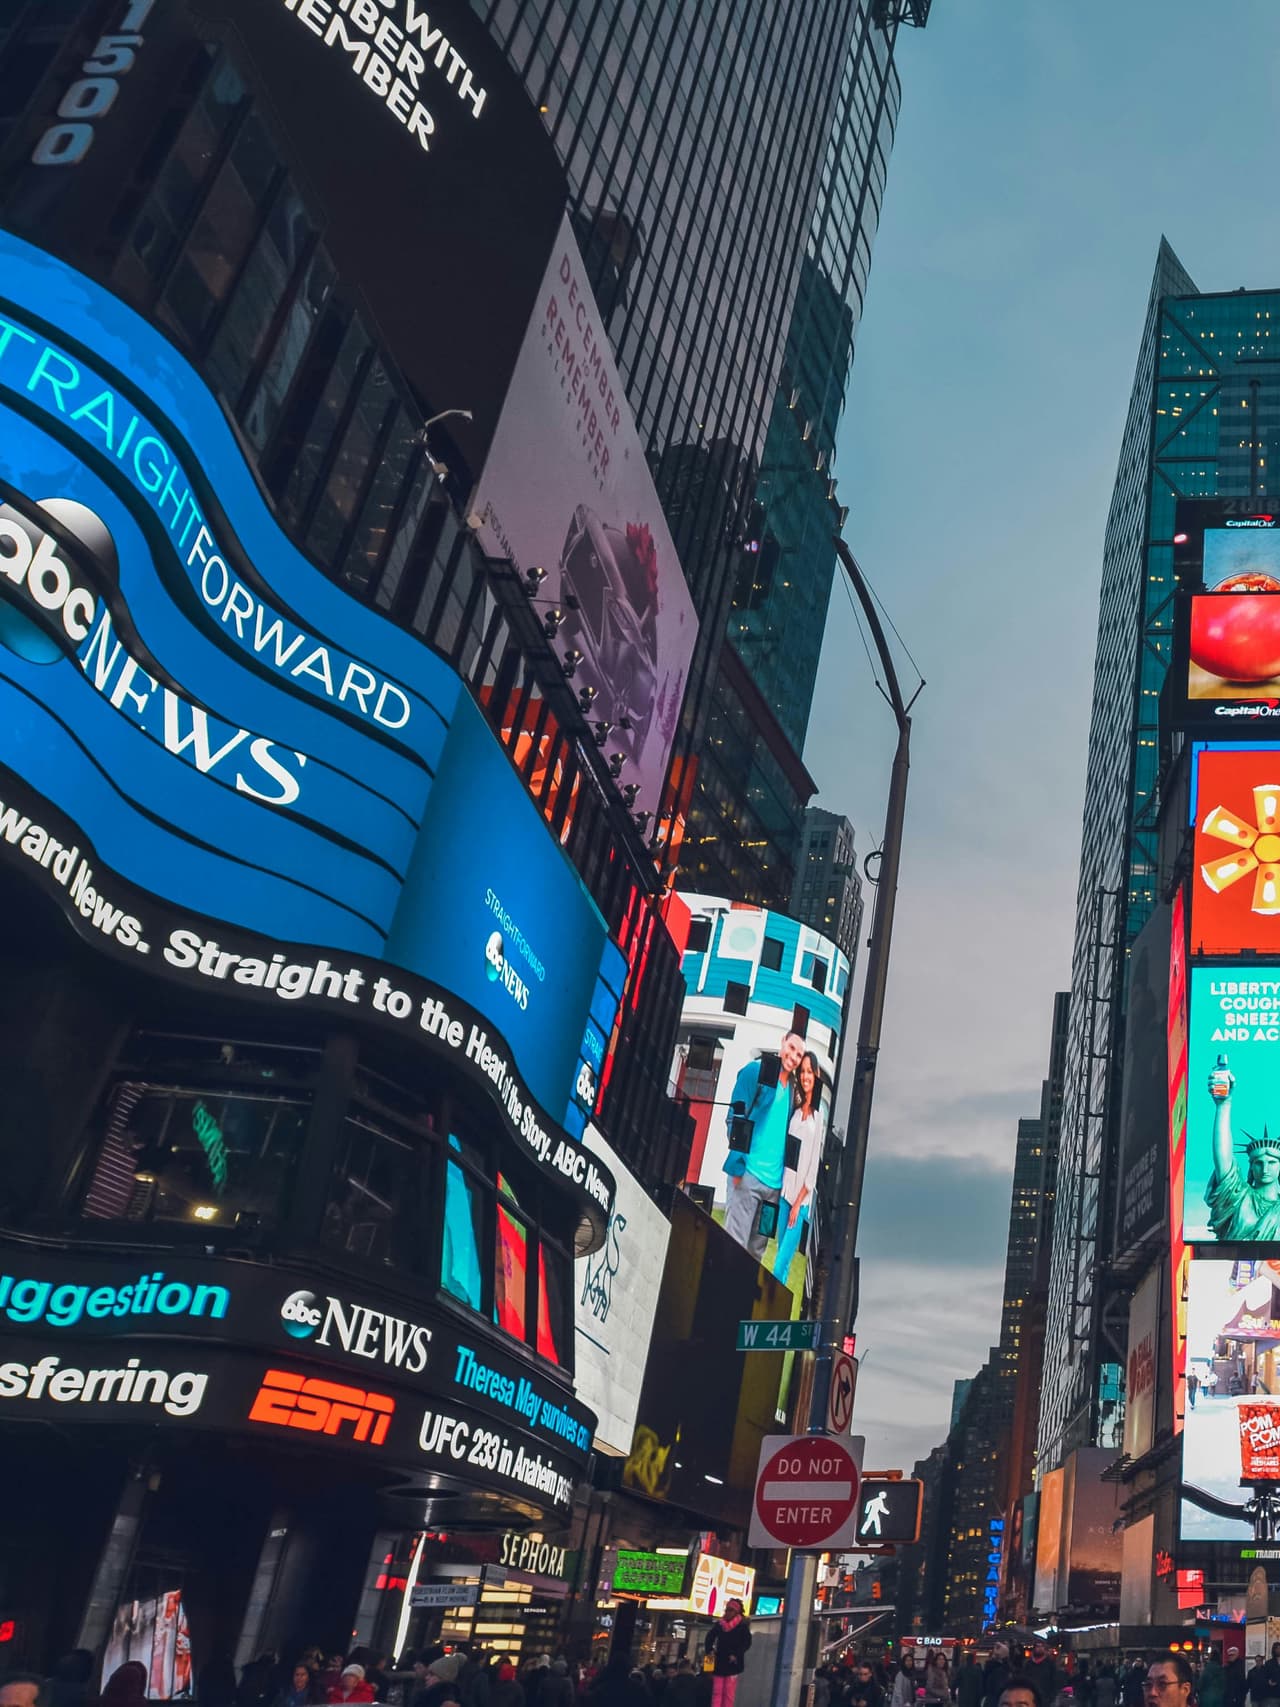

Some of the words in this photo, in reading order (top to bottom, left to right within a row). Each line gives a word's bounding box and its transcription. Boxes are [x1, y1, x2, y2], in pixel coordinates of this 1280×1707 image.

[405, 0, 487, 119] WITH
[559, 253, 620, 435] DECEMBER
[546, 295, 609, 475] REMEMBER
[0, 517, 95, 642] abc
[485, 887, 546, 982] STRAIGHTFORWARD
[69, 859, 152, 954] News.
[163, 928, 365, 1000] Straight
[372, 976, 413, 1019] to
[419, 996, 465, 1049] the
[465, 1024, 508, 1093] Heart
[551, 1140, 587, 1184] ABC
[499, 959, 531, 1011] NEWS
[1210, 982, 1280, 996] LIBERTY
[1210, 1028, 1251, 1042] AND
[280, 1299, 323, 1327] abc
[315, 1296, 433, 1374] NEWS
[743, 1325, 759, 1347] W
[765, 1325, 792, 1346] 44
[800, 1324, 813, 1338] ST
[248, 1368, 396, 1446] ESPN
[453, 1343, 515, 1408] Theresa
[514, 1376, 543, 1428] May
[540, 1404, 578, 1446] survives
[1240, 1413, 1274, 1438] POM
[419, 1410, 470, 1459] UFC
[467, 1427, 501, 1471] 233
[498, 1438, 514, 1477] in
[511, 1446, 558, 1495] Anaheim
[777, 1458, 802, 1475] DO
[808, 1458, 844, 1475] NOT
[775, 1507, 832, 1525] ENTER
[500, 1533, 565, 1578] SEPHORA
